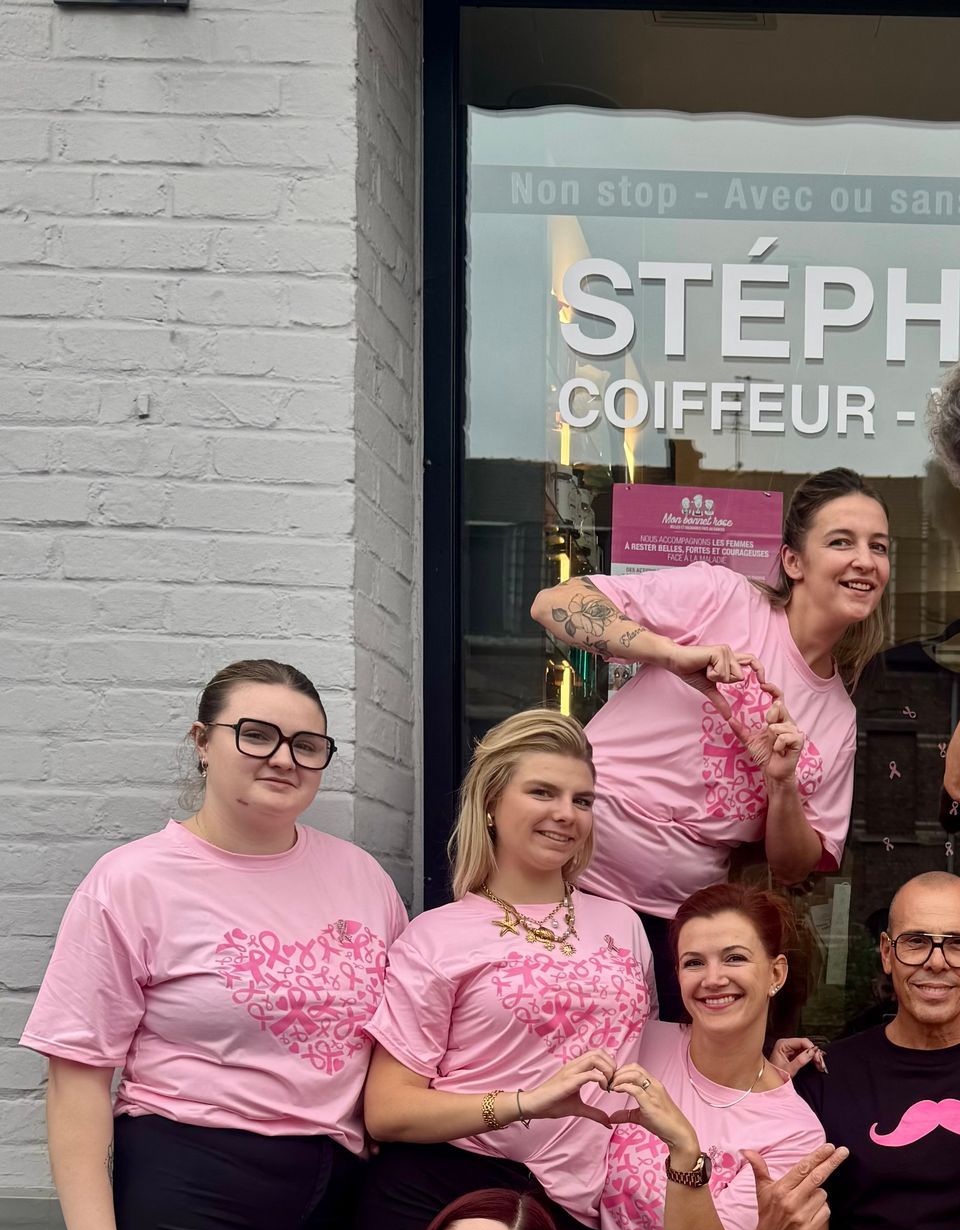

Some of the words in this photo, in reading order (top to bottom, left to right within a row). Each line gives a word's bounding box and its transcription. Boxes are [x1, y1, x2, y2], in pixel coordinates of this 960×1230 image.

[511, 171, 580, 206] Non
[598, 175, 677, 214] stop
[724, 177, 813, 212] Avec
[830, 186, 872, 213] ou
[558, 376, 876, 436] COIFFEUR
[662, 512, 682, 526] Mon
[683, 514, 712, 527] bonnet
[713, 516, 734, 528] rose
[640, 535, 658, 543] NOUS
[659, 536, 711, 546] ACCOMPAGNONS
[712, 539, 725, 547] LES
[726, 540, 754, 549] FEMMES
[631, 543, 657, 552] RESTER
[685, 547, 711, 555] FORTES
[712, 547, 720, 555] ET
[721, 548, 770, 558] COURAGEUSES
[667, 554, 683, 562] FACE
[690, 555, 698, 563] LA
